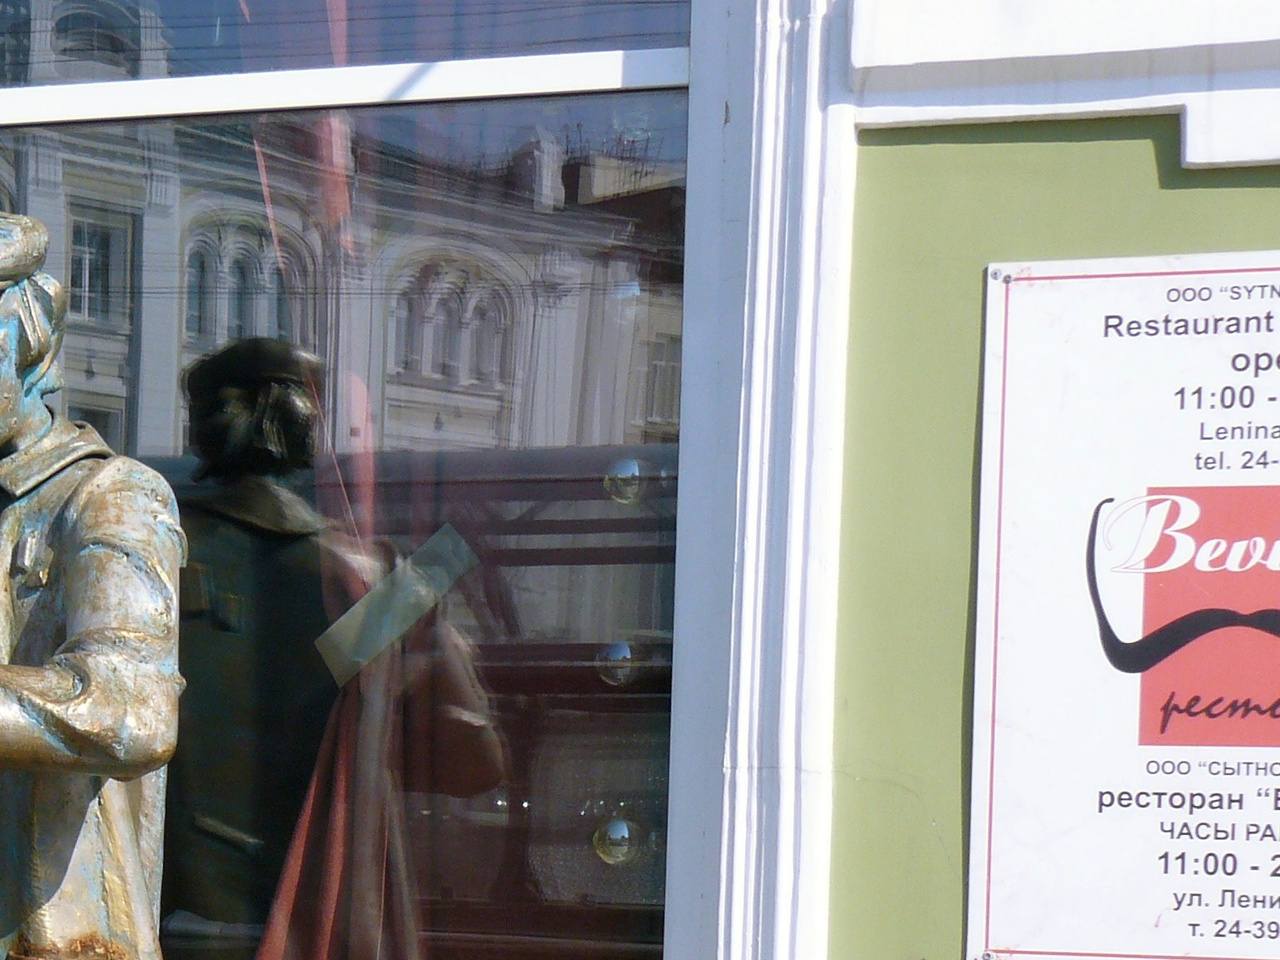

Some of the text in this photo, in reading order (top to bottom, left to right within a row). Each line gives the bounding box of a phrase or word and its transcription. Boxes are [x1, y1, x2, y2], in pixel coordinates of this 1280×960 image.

[1103, 310, 1274, 338] Restaurant
[1231, 351, 1280, 378] op
[1174, 385, 1255, 410] 11:00
[1199, 421, 1280, 441] Lenina
[1195, 451, 1231, 470] tel.
[1098, 788, 1244, 815] ресторан
[1160, 822, 1280, 842] ЧАСЫ РА
[1158, 851, 1238, 876] 11:00
[1173, 891, 1209, 911] ул.
[1188, 919, 1280, 940] т. 24-39
